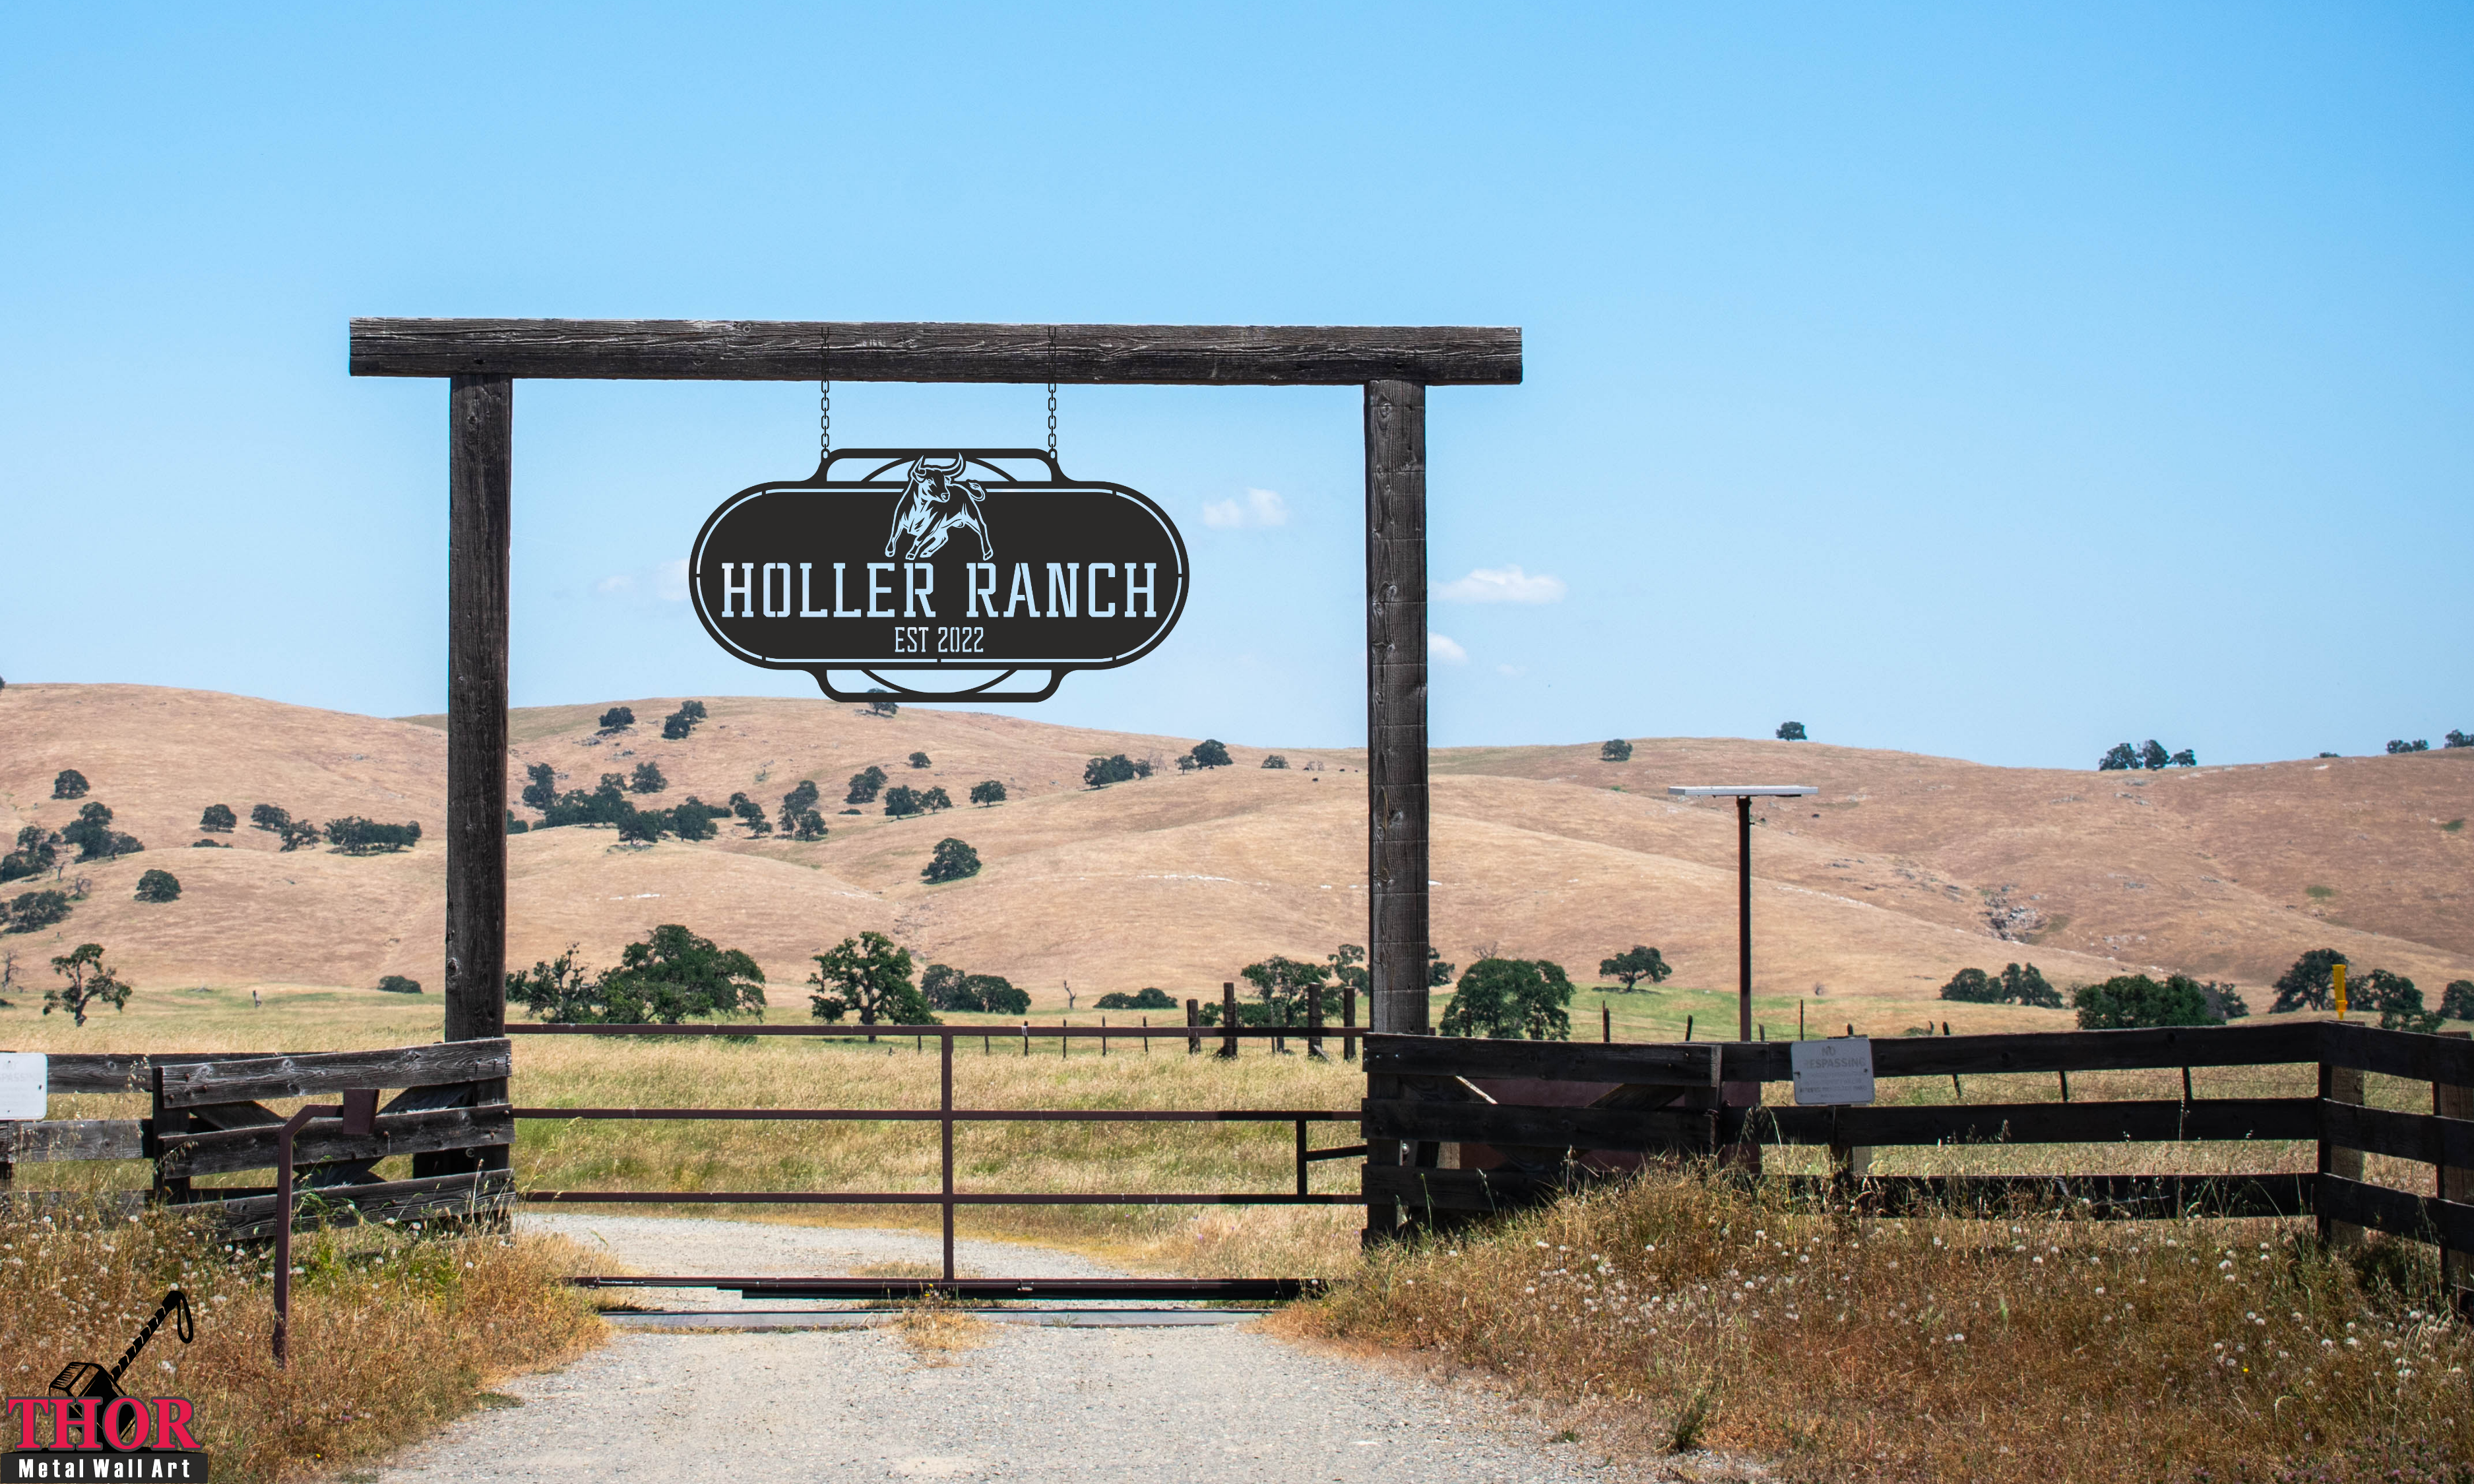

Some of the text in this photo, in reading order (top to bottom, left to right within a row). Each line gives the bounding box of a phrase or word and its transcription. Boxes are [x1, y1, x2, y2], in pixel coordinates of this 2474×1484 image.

[722, 563, 1157, 617] HOLLER RANCH
[895, 627, 984, 652] EST 2022
[1822, 1045, 1836, 1056] NO
